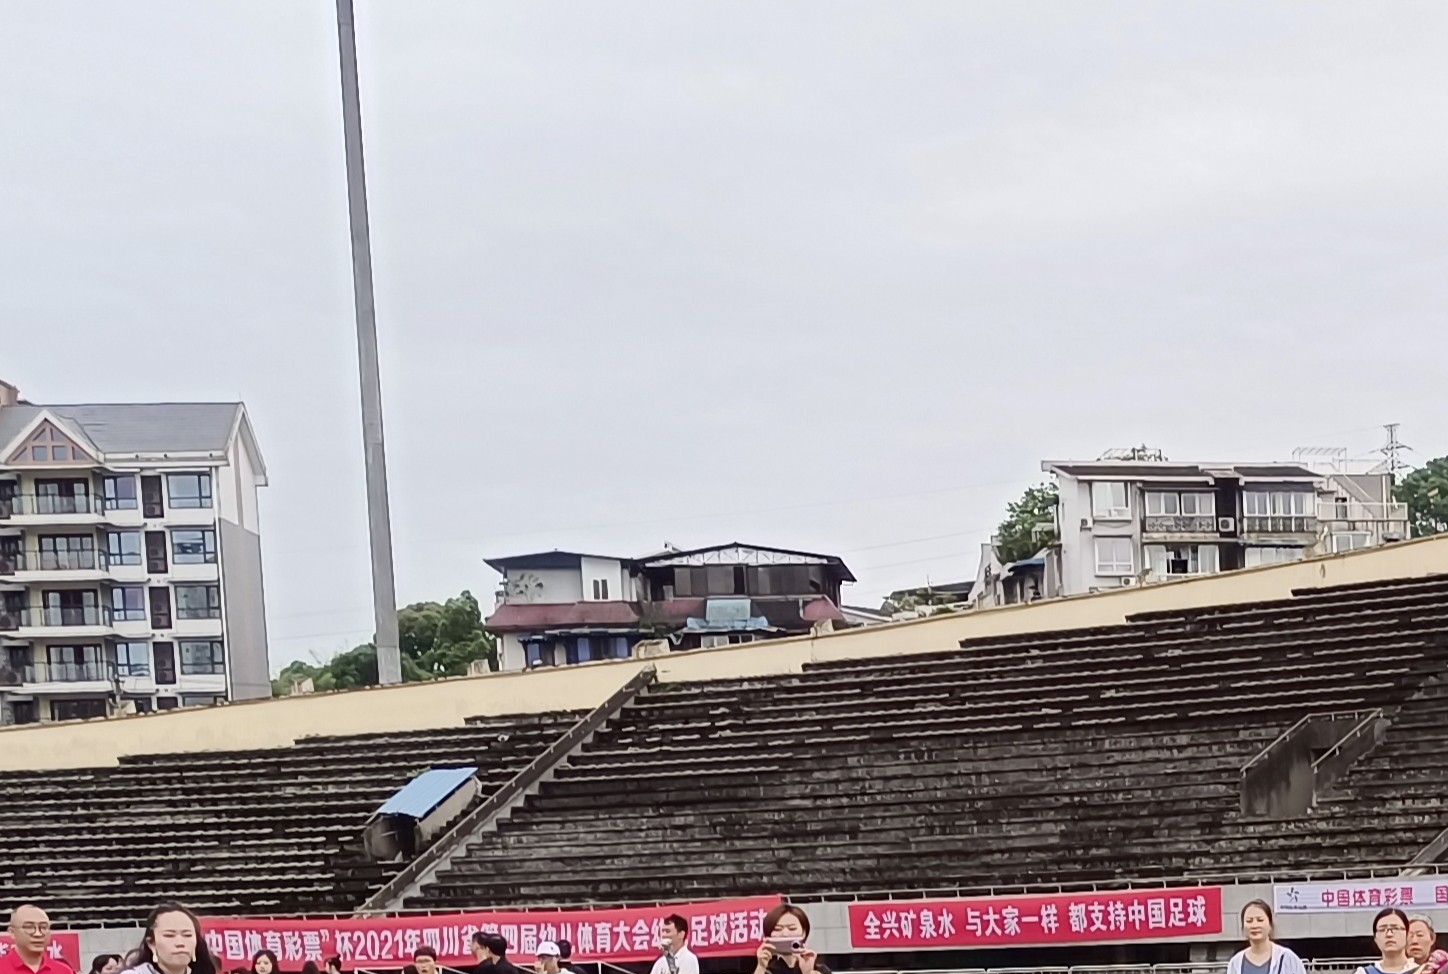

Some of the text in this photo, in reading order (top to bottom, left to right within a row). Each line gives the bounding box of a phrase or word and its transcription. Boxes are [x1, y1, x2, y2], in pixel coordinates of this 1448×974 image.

[863, 895, 1207, 941] 全兴矿泉水 与大家一样 都支持中国足球
